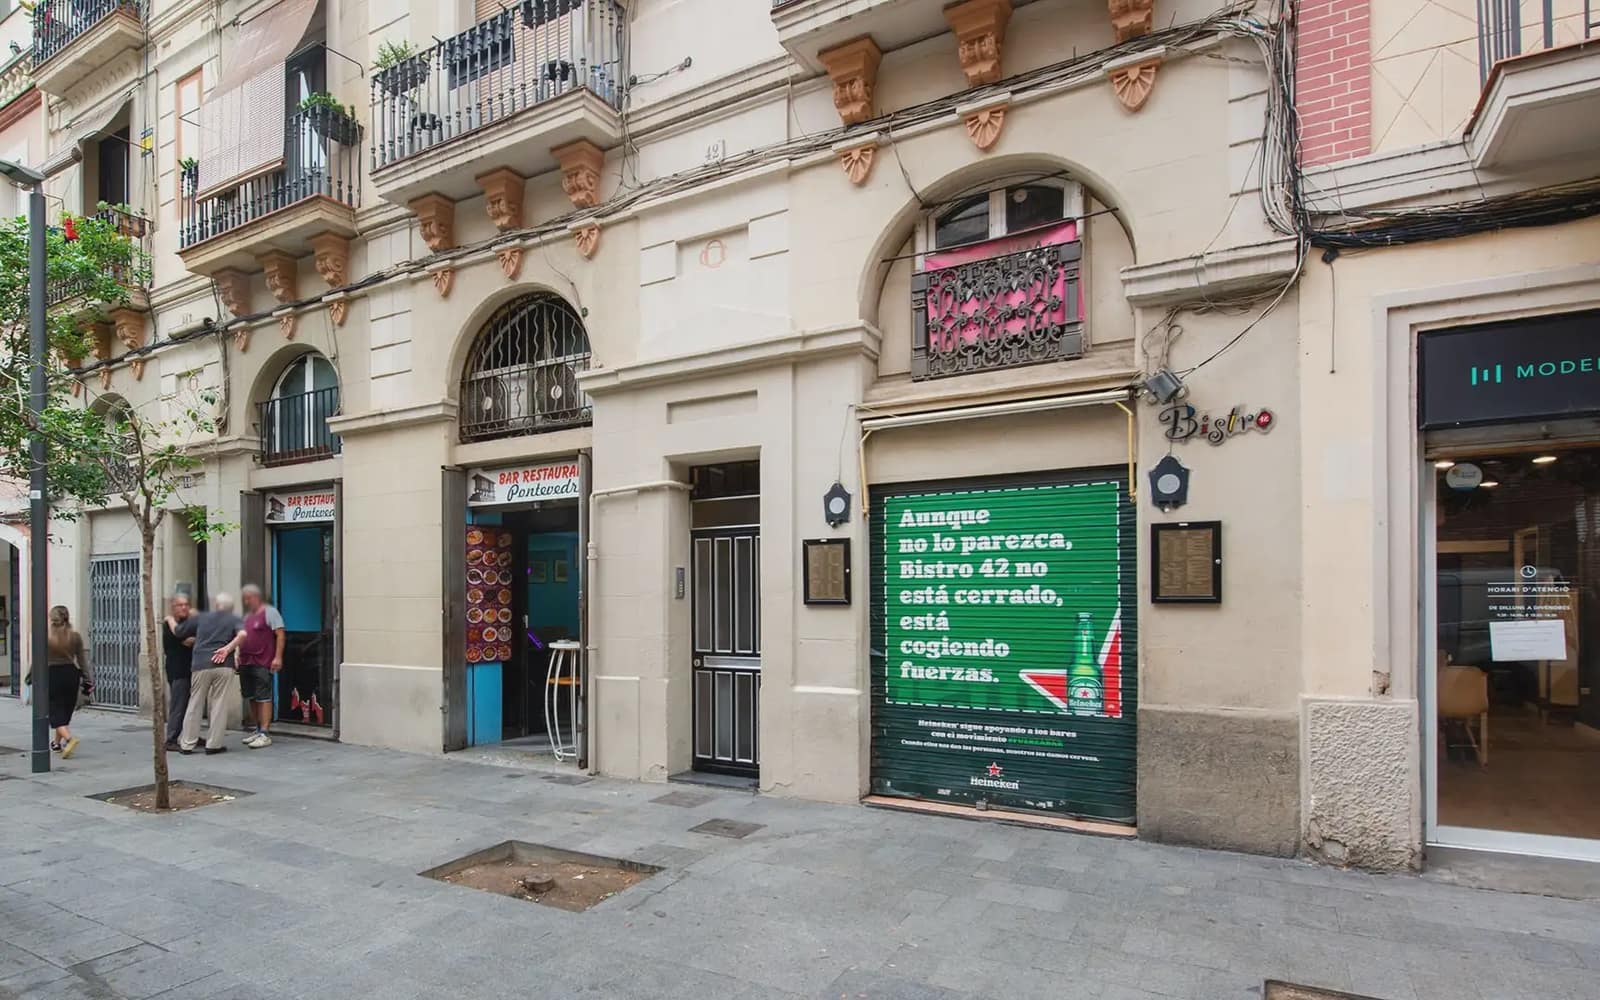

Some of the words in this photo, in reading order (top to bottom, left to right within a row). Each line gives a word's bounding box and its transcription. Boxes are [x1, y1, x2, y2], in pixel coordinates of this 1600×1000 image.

[1158, 402, 1273, 443] Bistro
[498, 471, 520, 486] BAR
[523, 464, 579, 483] RESTAURA
[287, 496, 302, 507] BAR
[898, 509, 990, 530] Aunque
[898, 537, 928, 553] no
[932, 533, 956, 552] lo
[959, 532, 1073, 555] parezca,
[899, 559, 974, 579] Bistro
[978, 557, 1010, 578] 42
[1015, 561, 1049, 577] no
[899, 584, 950, 605] está
[954, 584, 1064, 607] cerrado,
[899, 610, 950, 631] está
[899, 635, 1011, 658] cogiendo
[900, 660, 1000, 683] fuerzas.
[956, 732, 1008, 743] movimiento
[959, 723, 984, 731] sigue
[984, 724, 1026, 734] apoyando
[1049, 728, 1077, 738] bares
[970, 775, 1019, 790] Heineken
